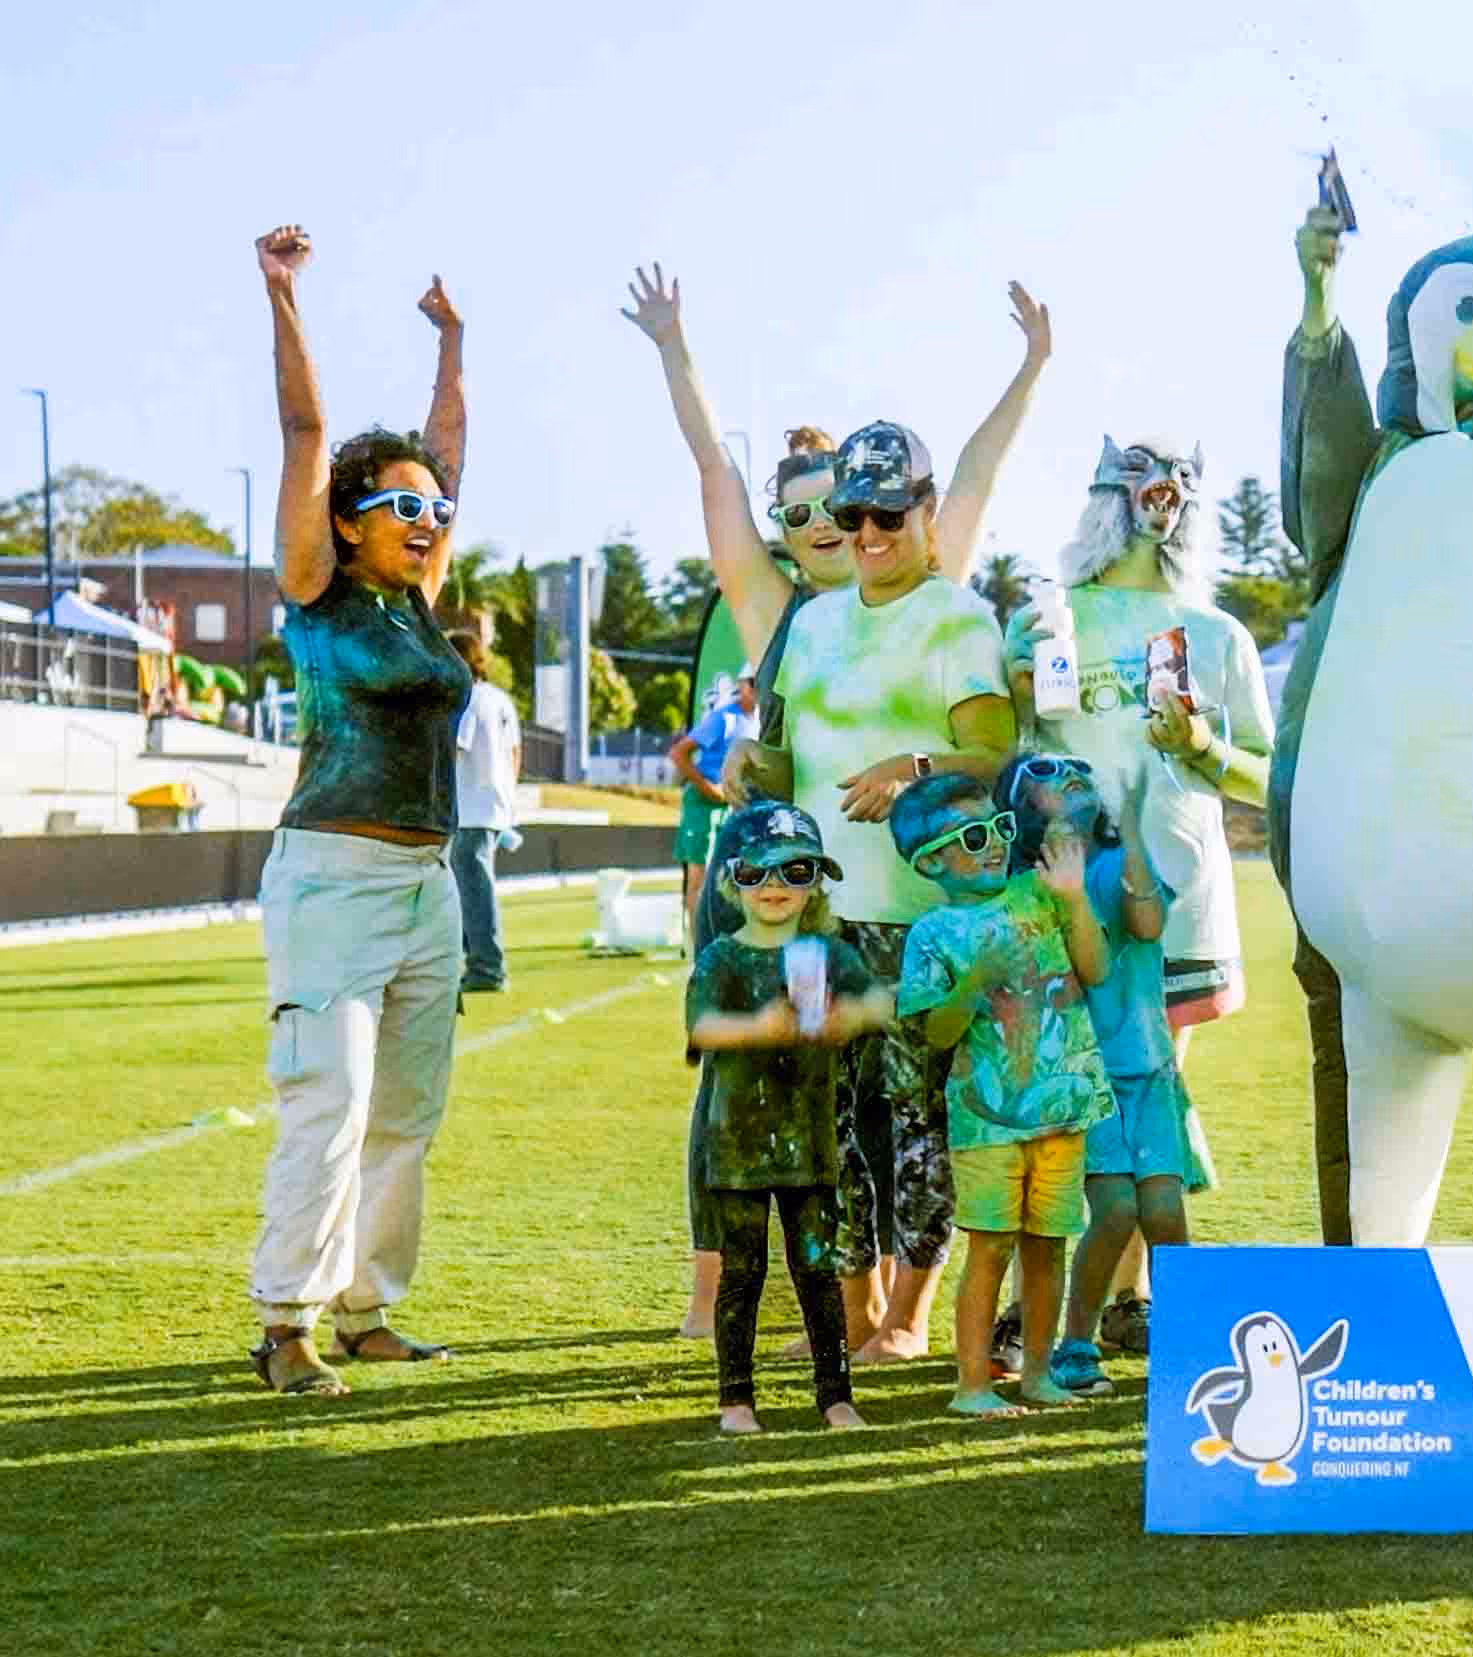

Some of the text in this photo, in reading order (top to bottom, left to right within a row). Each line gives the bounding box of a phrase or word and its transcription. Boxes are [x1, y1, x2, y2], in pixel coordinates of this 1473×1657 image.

[1313, 1379, 1435, 1401] Children's
[1312, 1405, 1408, 1426] Tumour
[1312, 1431, 1453, 1453] Foundation
[1312, 1460, 1410, 1479] CONQUERING NF
